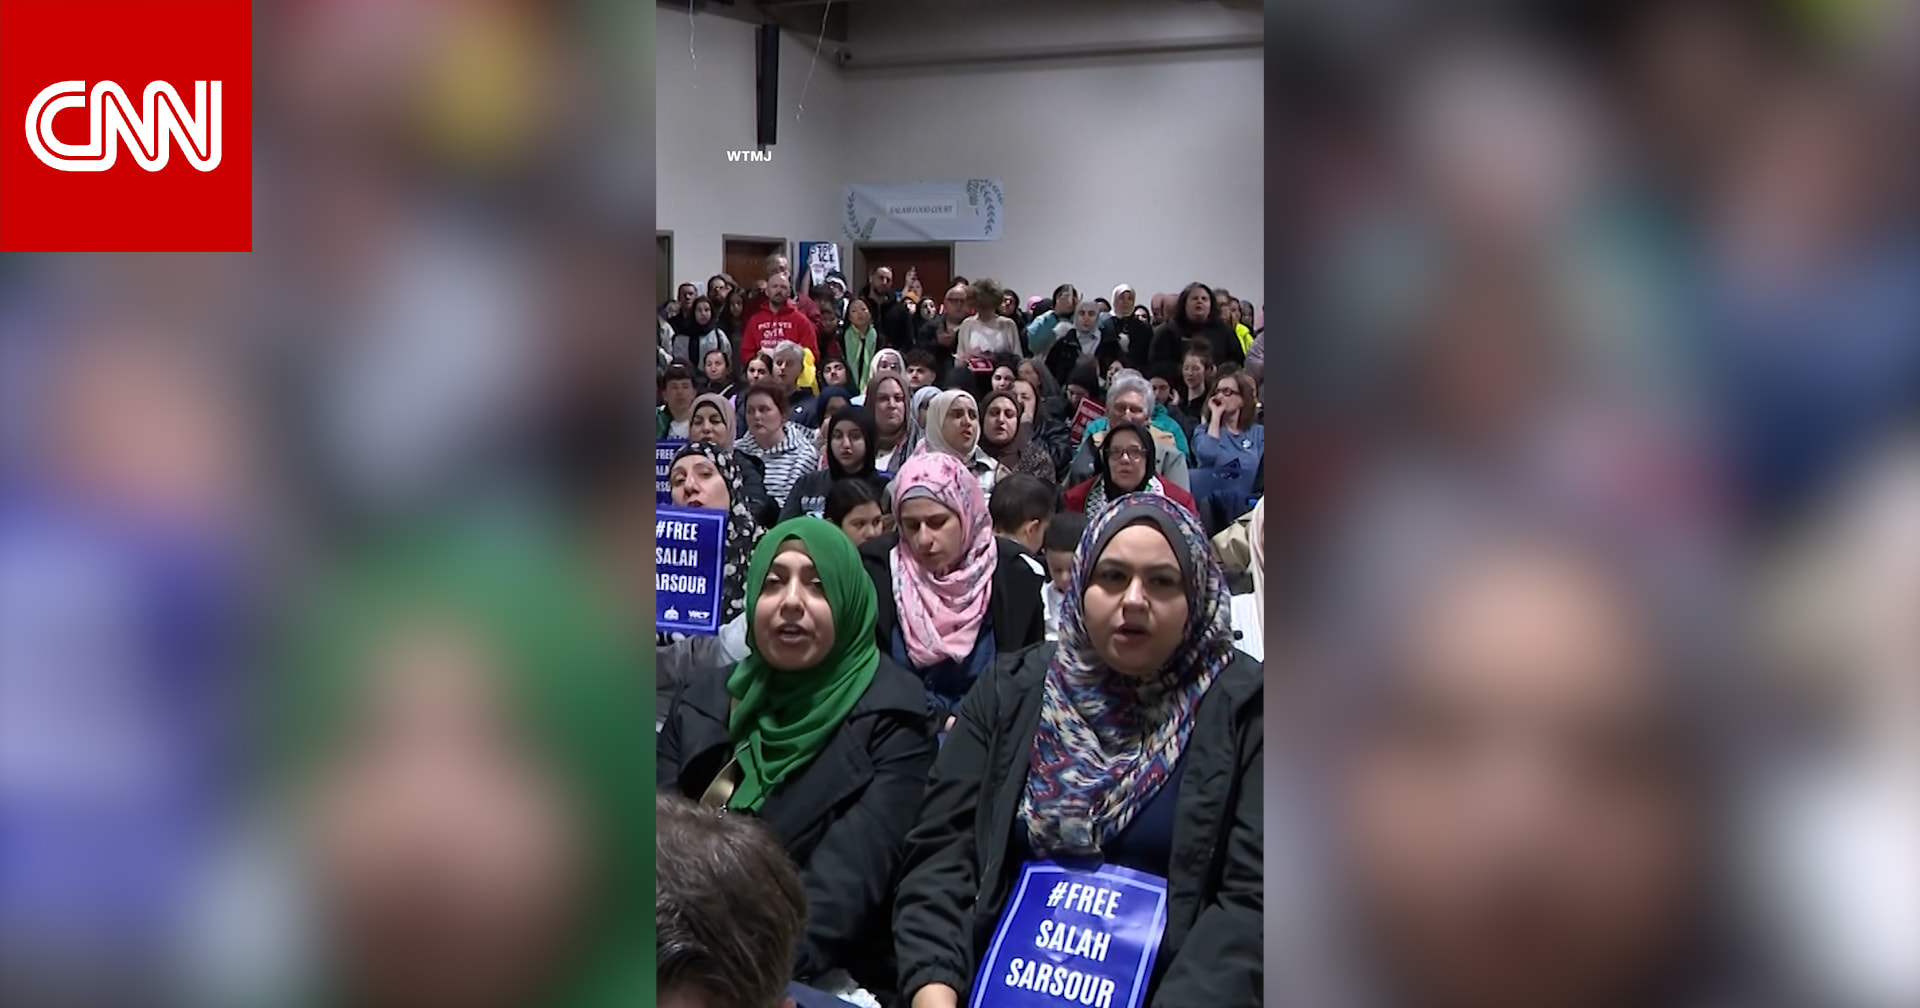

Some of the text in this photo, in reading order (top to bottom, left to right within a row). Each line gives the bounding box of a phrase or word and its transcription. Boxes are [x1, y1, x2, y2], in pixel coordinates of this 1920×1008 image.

[656, 520, 699, 541] #FREE
[656, 547, 698, 567] SALAH
[1046, 881, 1122, 919] #FREE
[1035, 919, 1111, 962] SALAH
[1005, 957, 1116, 1008] SARSOUR
